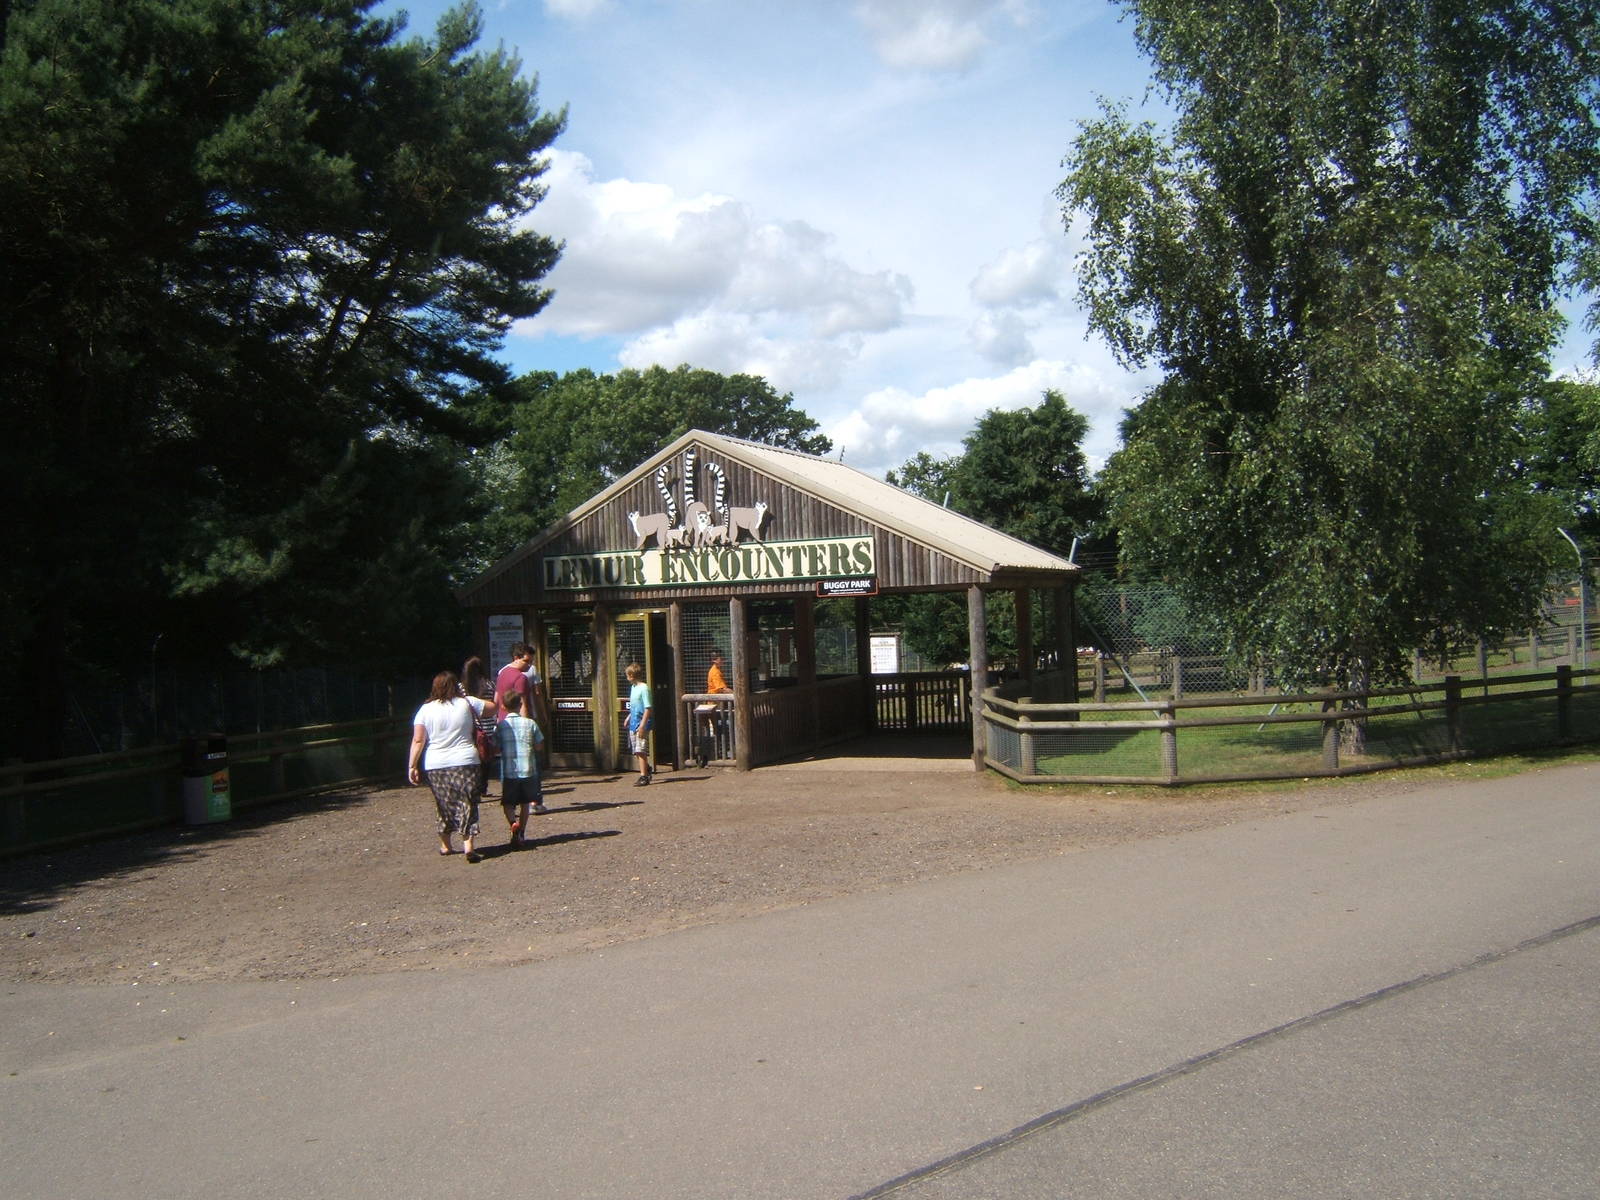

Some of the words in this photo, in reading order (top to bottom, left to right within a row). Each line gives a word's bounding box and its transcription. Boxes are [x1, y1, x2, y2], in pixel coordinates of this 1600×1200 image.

[545, 555, 647, 587] LEMUR
[660, 541, 872, 583] ENCOUNTERS
[824, 581, 850, 590] BUGGY
[850, 580, 871, 588] PARK
